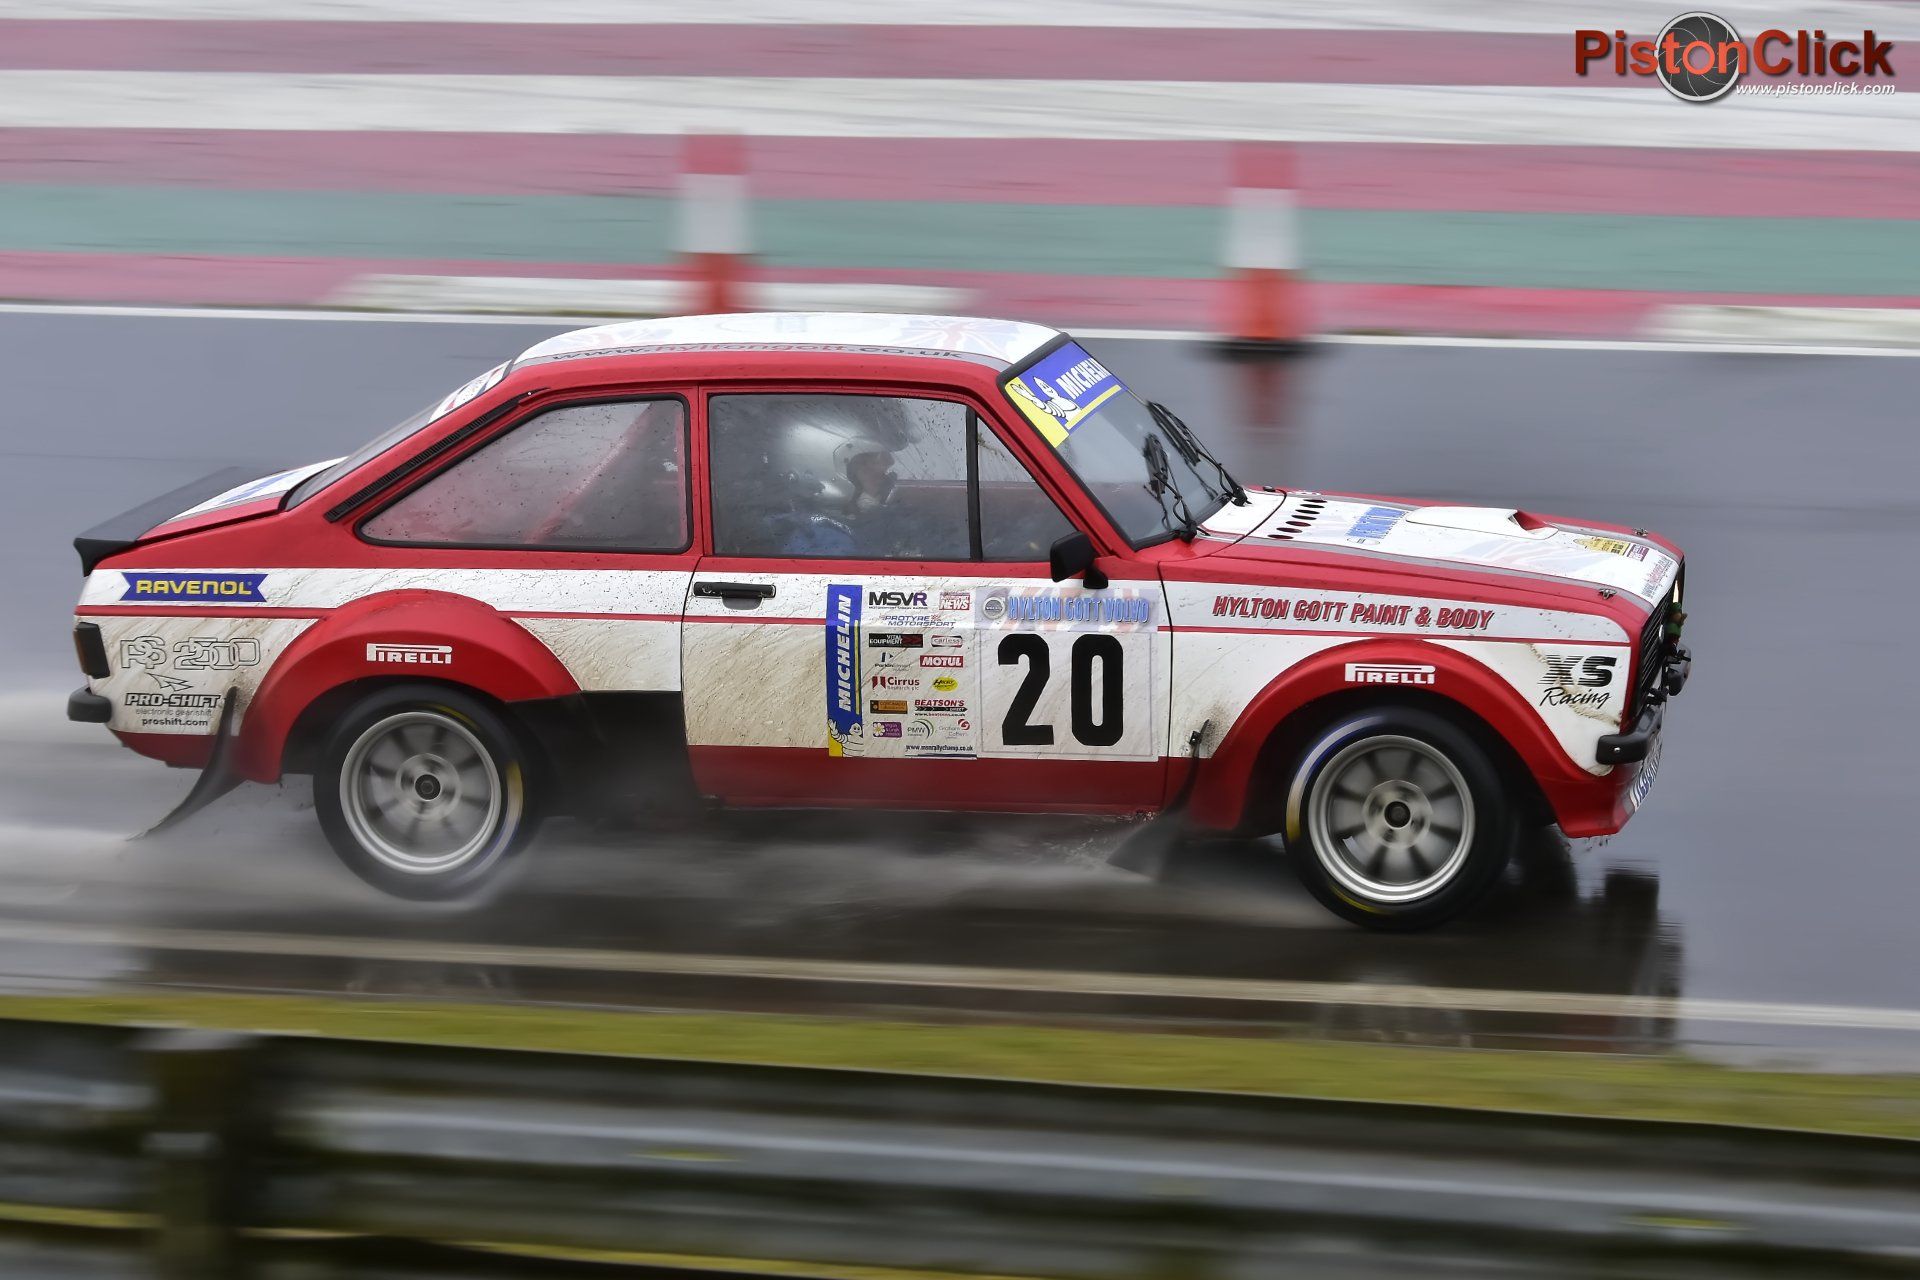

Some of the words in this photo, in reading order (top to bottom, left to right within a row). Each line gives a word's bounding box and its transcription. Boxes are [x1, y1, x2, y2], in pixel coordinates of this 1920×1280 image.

[1056, 358, 1111, 399] MICHELI
[135, 578, 252, 596] RAVENOL
[869, 592, 928, 606] MSVR
[940, 598, 969, 610] NEWS
[1009, 596, 1061, 621] HYLTON
[1064, 597, 1101, 621] GOTT
[1104, 598, 1149, 623] VOLVO
[1212, 596, 1290, 619] HYLTON
[1293, 600, 1346, 621] GOTT
[1350, 603, 1412, 626] PAINT
[1415, 607, 1431, 626] &
[1436, 608, 1494, 630] BODY
[120, 635, 167, 669] RS
[367, 643, 453, 664] PIRELLI
[837, 594, 851, 712] MICHELIN
[922, 657, 962, 666] MOTUL
[887, 677, 920, 686] Cirrus
[1345, 663, 1435, 684] PIRELLI
[1537, 655, 1617, 687] XS
[125, 693, 221, 707] PRO-SHIFT
[998, 634, 1123, 746] 20
[1540, 686, 1612, 709] Racing
[142, 717, 208, 726] proshift.com
